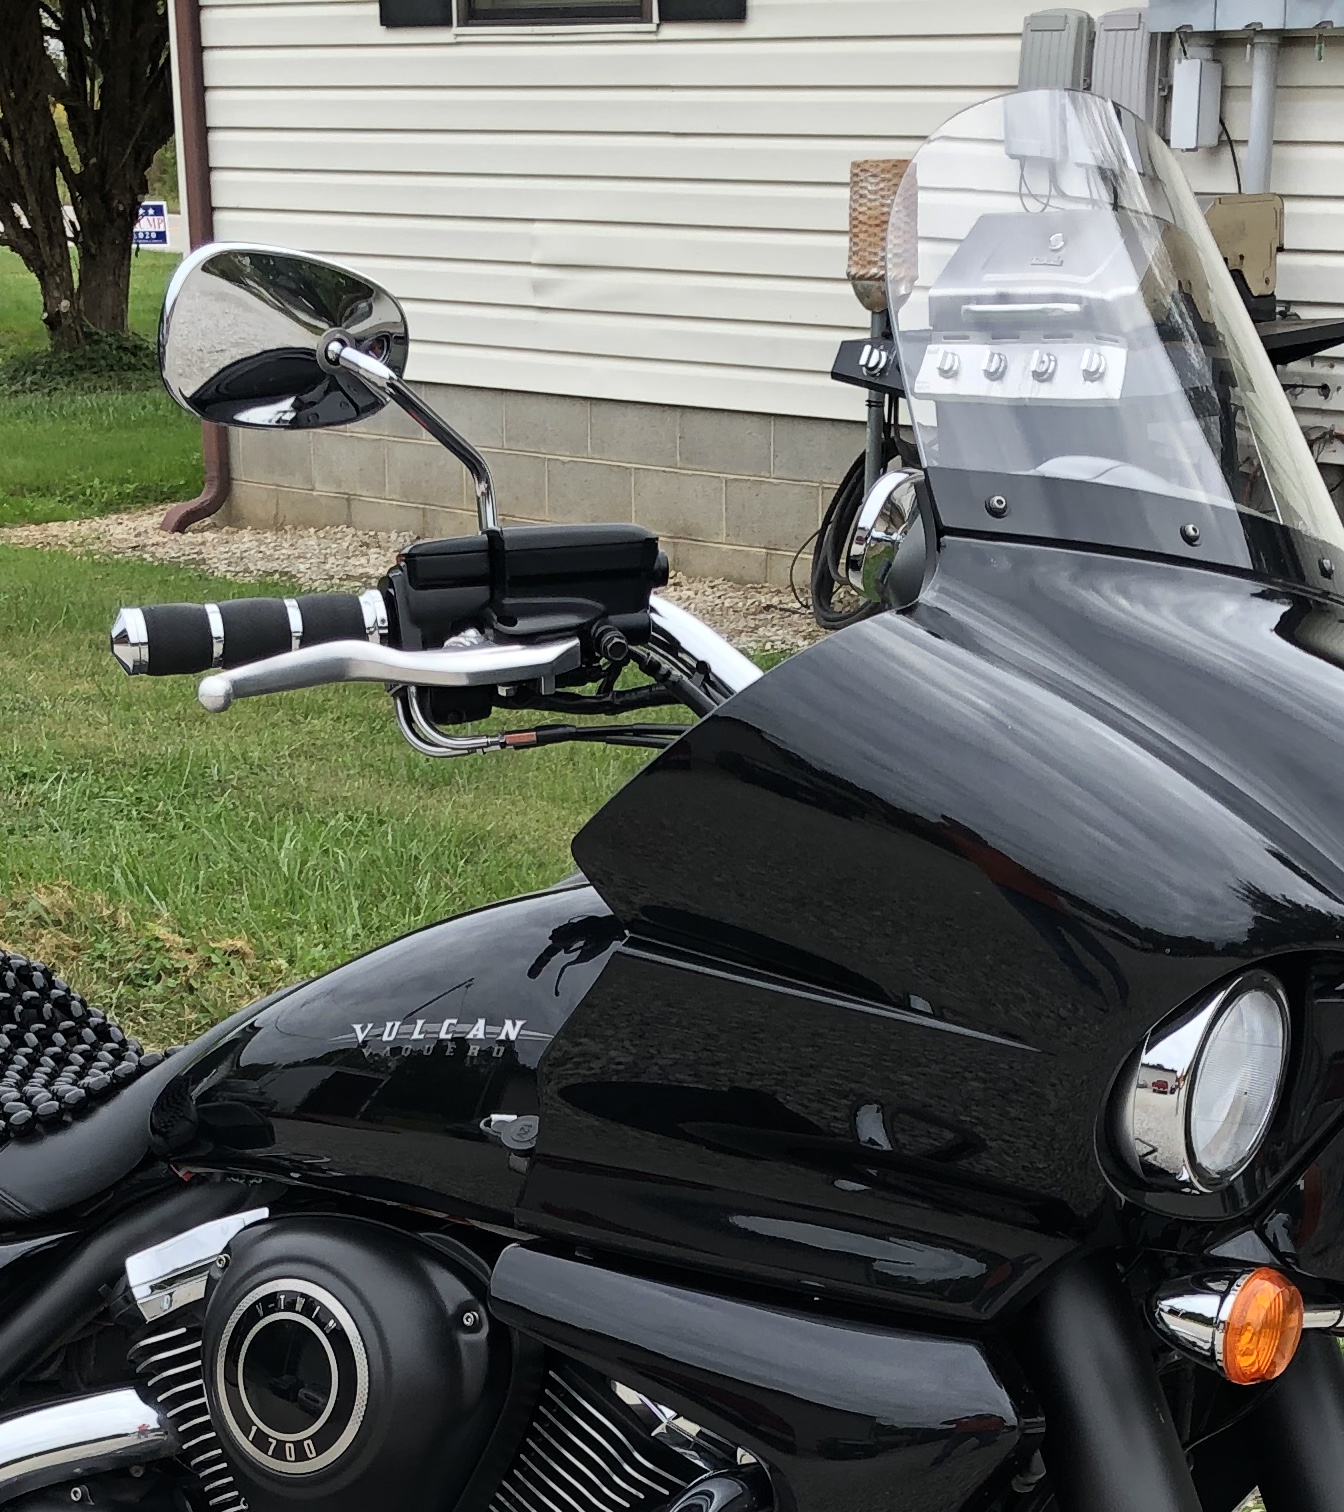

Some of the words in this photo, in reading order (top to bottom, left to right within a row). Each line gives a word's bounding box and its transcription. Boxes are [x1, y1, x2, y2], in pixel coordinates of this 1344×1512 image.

[350, 1017, 528, 1043] VULCAN
[361, 1041, 506, 1059] VAQUERO
[255, 1294, 337, 1334] V-TWIN
[248, 1425, 317, 1462] 1700
